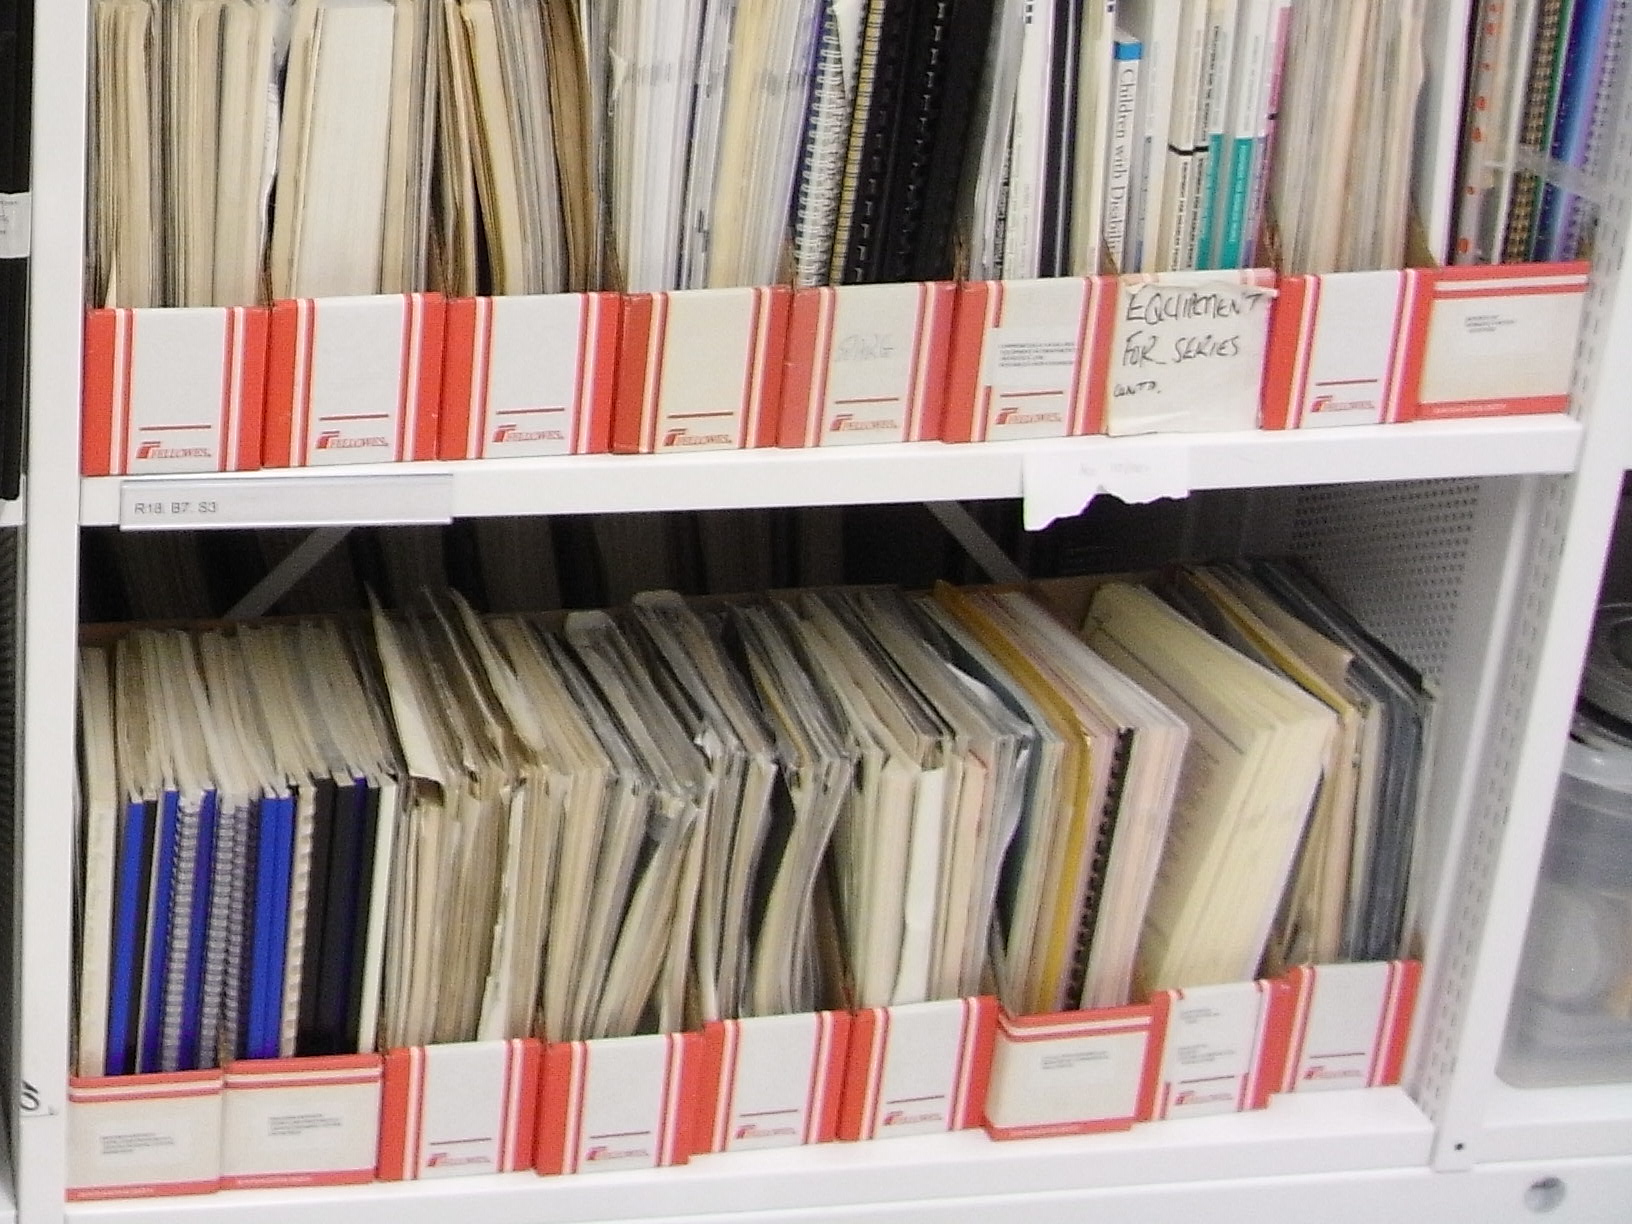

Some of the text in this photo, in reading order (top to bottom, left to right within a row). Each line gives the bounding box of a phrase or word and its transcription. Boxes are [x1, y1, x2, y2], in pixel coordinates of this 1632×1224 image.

[1112, 68, 1138, 146] Children
[1109, 149, 1129, 184] with
[1124, 292, 1264, 326] EQUIPMENT
[1122, 334, 1241, 367] FOR SERIES
[198, 501, 217, 514] S3
